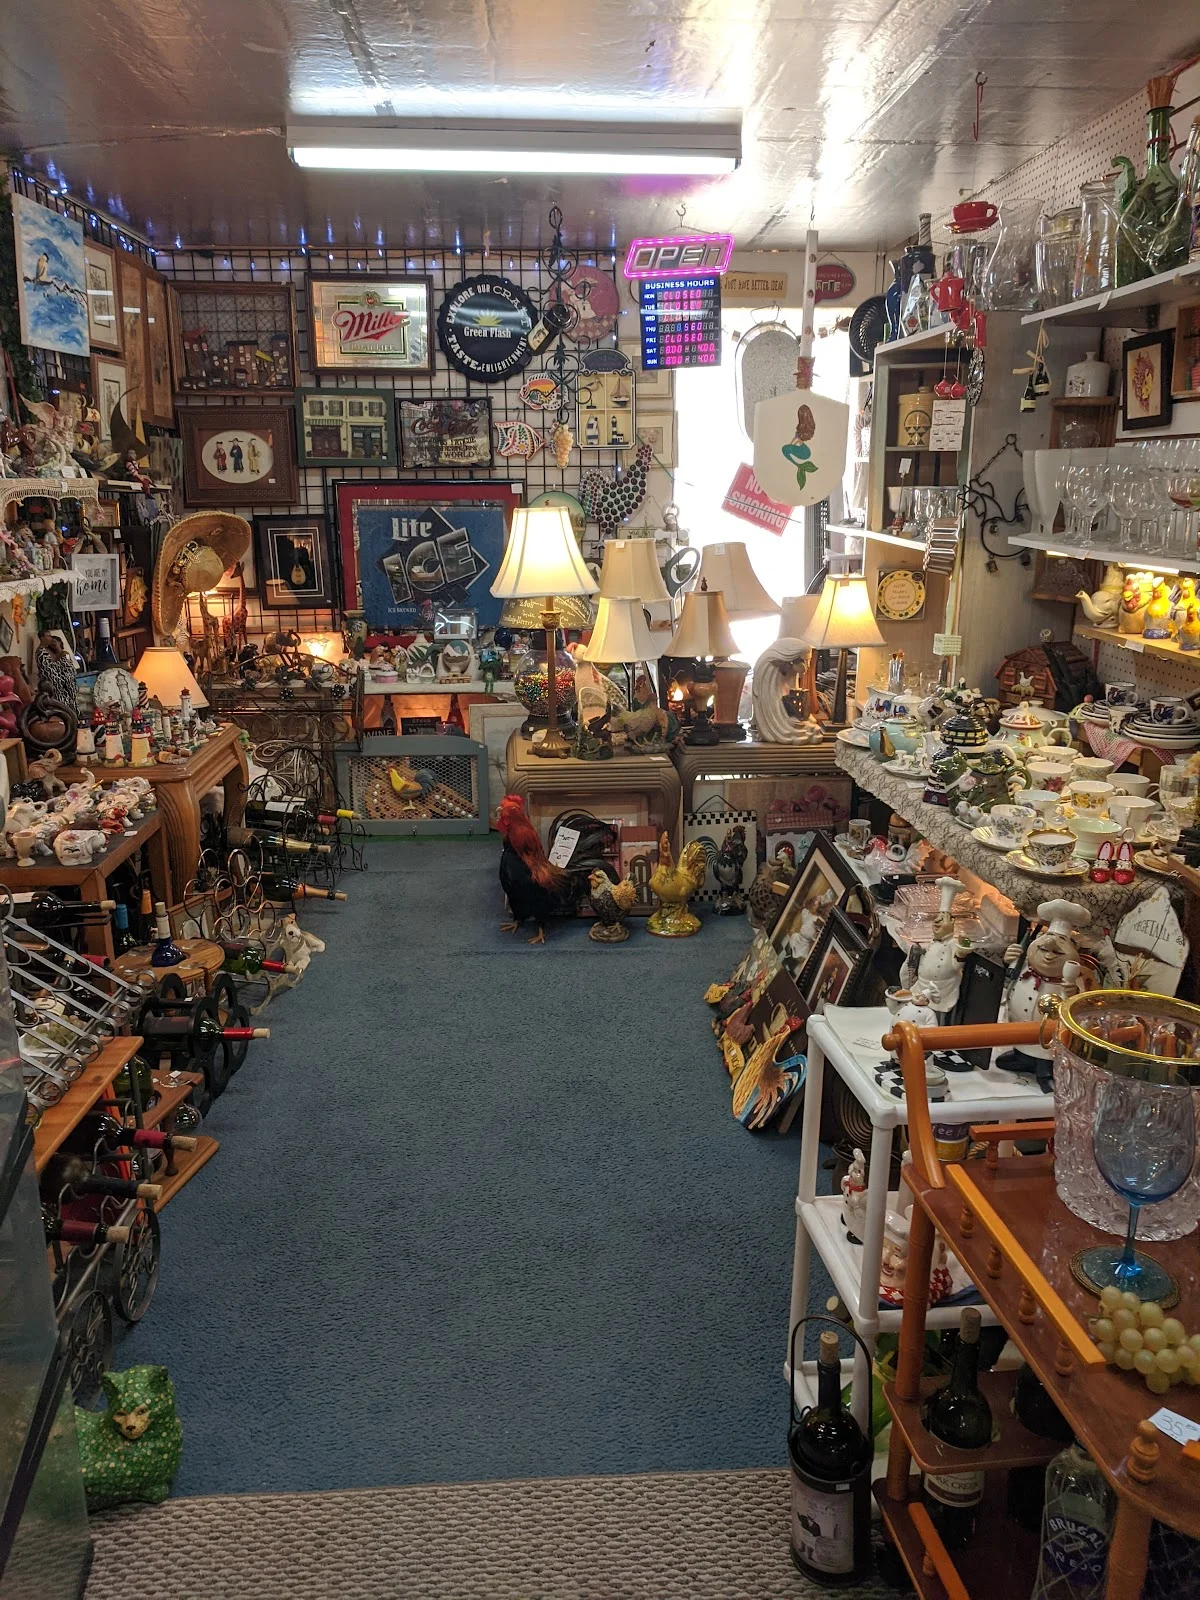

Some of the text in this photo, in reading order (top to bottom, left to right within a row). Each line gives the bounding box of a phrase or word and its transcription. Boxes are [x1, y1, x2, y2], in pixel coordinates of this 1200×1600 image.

[632, 245, 723, 271] OPEN
[645, 281, 685, 290] BUSINESS
[724, 277, 737, 290] JUST
[751, 279, 770, 291] BETTER
[446, 287, 475, 325] EXPLORE
[476, 283, 491, 294] OUR
[464, 326, 512, 339] Green Flash
[664, 332, 703, 343] CLOSED
[481, 336, 527, 373] ENLIGHTENMENT
[744, 473, 763, 495] NO
[728, 490, 788, 529] SMOKING
[391, 517, 433, 542] Lite
[382, 526, 477, 605] ICE
[76, 577, 109, 597] home
[1133, 919, 1171, 943] VEGETABLE
[1048, 1517, 1105, 1549] BRUGAL
